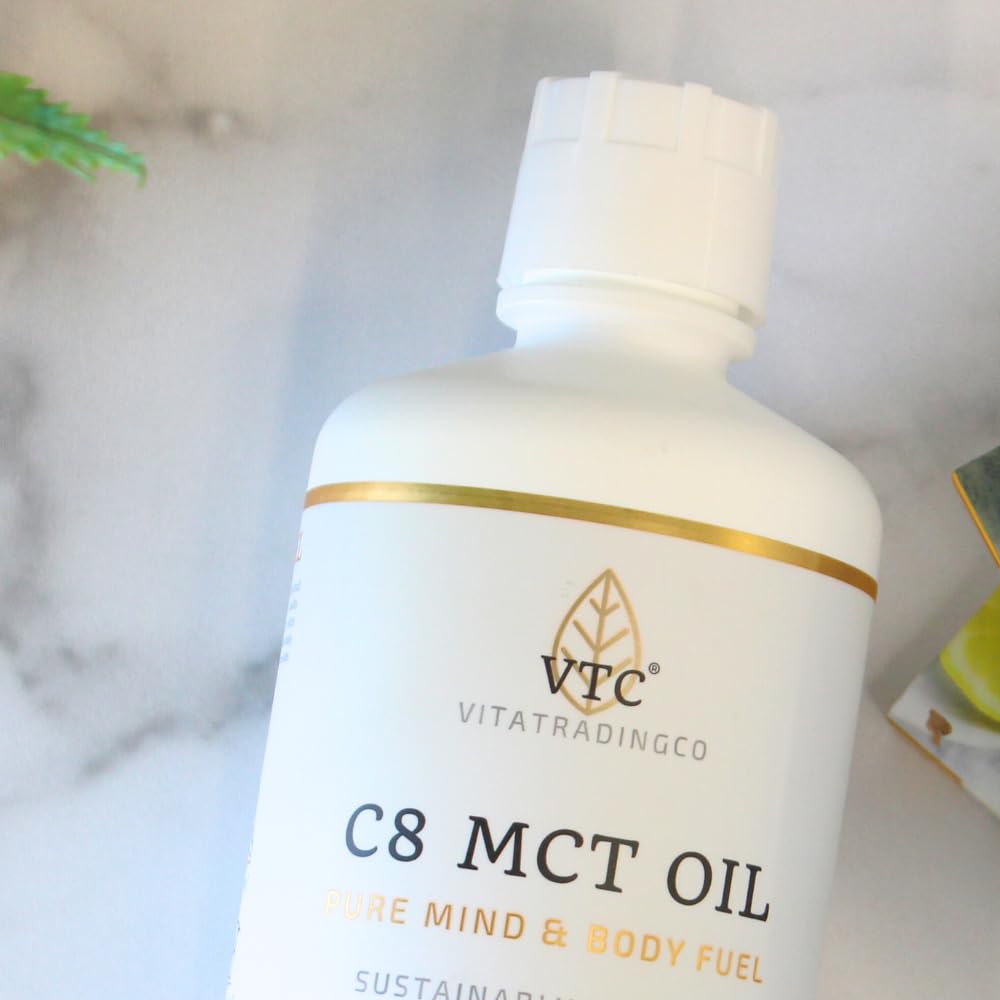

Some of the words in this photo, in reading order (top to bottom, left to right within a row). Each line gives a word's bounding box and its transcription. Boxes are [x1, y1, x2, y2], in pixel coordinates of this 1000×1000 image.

[458, 701, 708, 762] VITATRADINGCO
[345, 803, 426, 862] C8
[457, 815, 640, 893] MCT
[666, 852, 771, 921] OIL
[325, 889, 409, 925] PURE
[424, 901, 524, 939] MIND
[542, 919, 568, 947] &
[587, 924, 686, 967] BODY
[696, 944, 763, 984] FUEL
